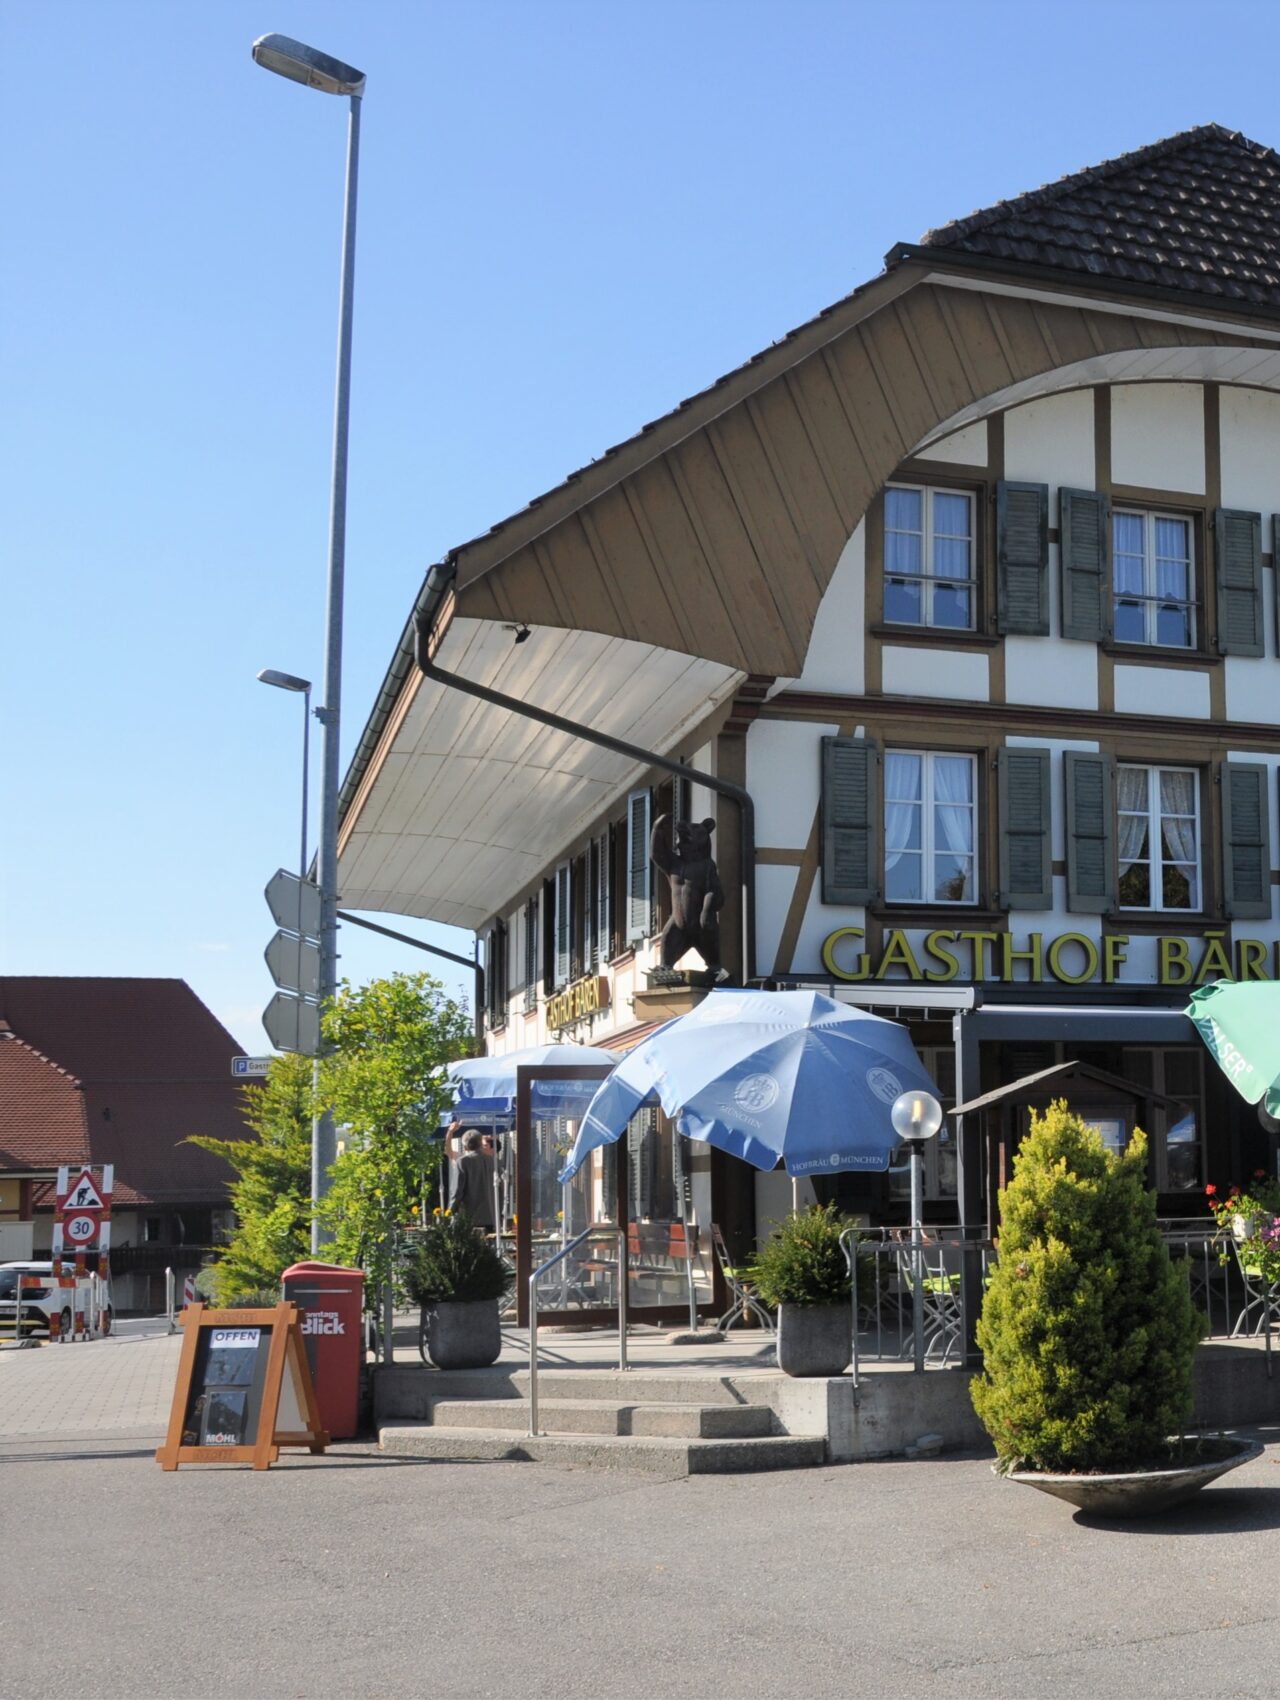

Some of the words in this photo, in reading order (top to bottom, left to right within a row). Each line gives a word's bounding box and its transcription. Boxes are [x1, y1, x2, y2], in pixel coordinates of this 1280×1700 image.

[821, 927, 1129, 984] GASTHOF
[73, 1222, 90, 1235] 30
[215, 1331, 257, 1342] OFFEN
